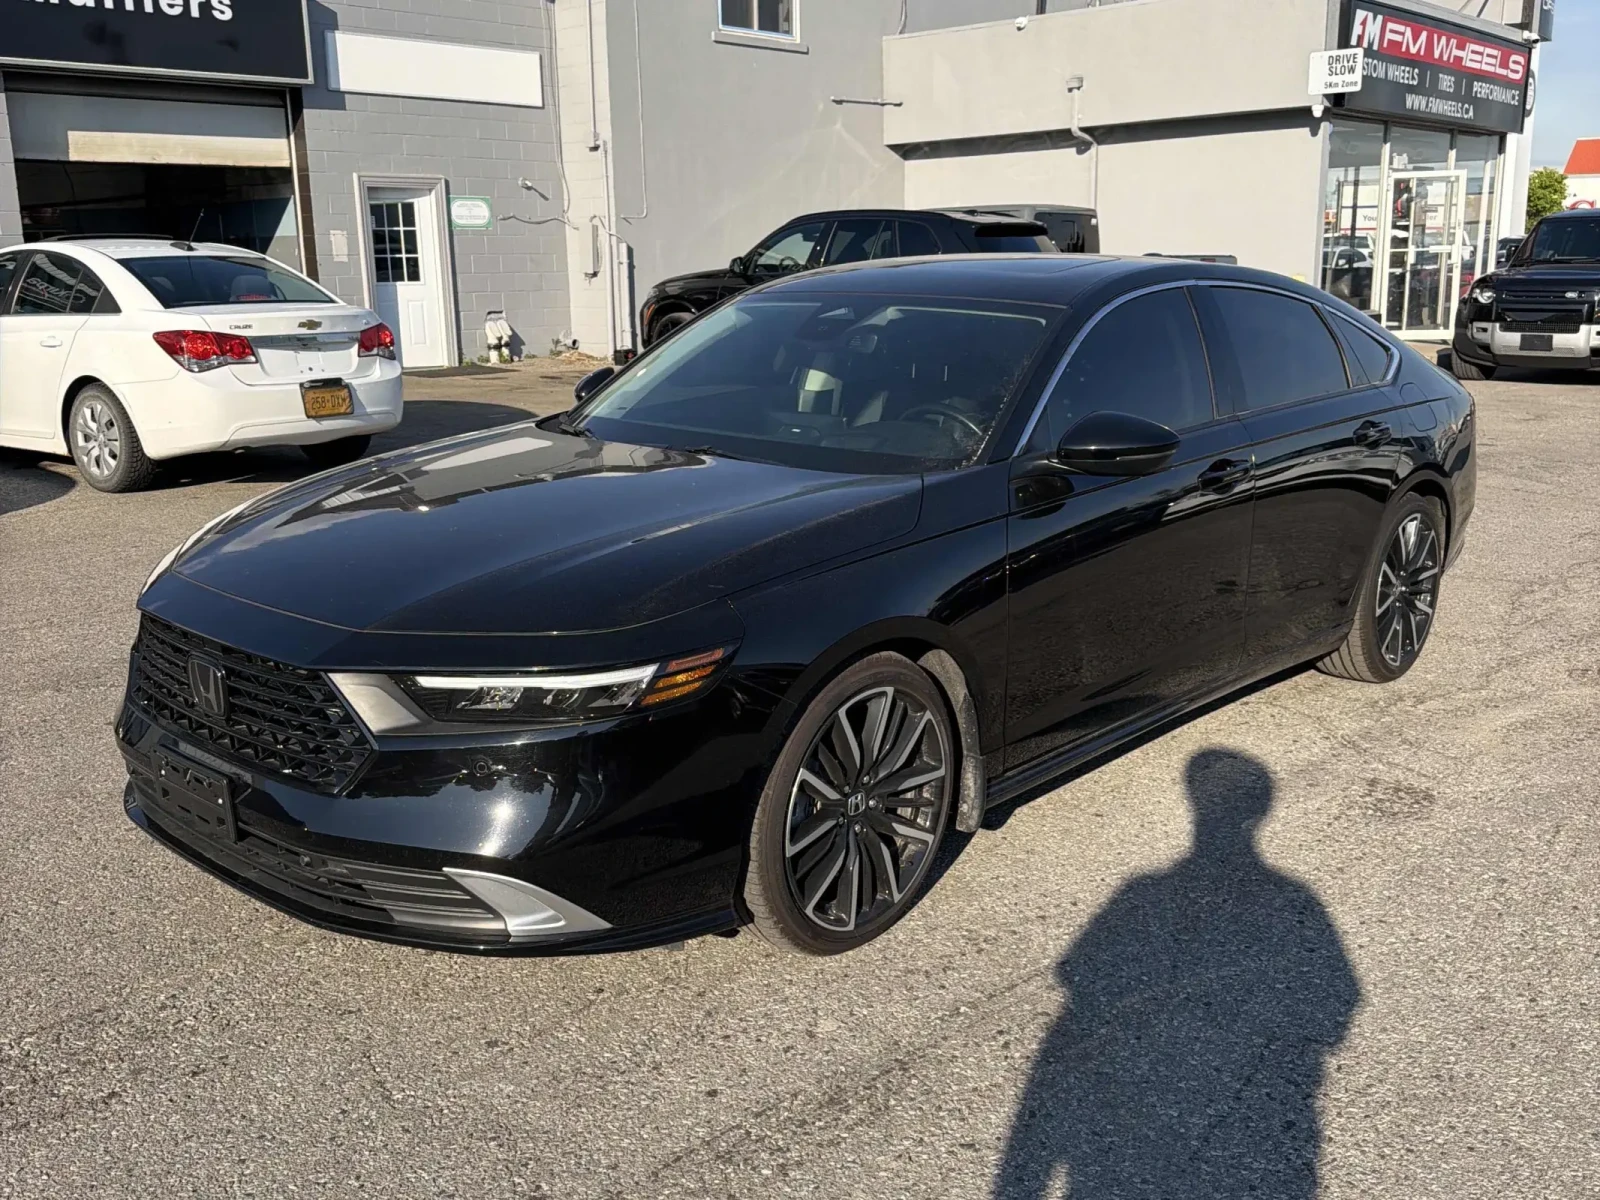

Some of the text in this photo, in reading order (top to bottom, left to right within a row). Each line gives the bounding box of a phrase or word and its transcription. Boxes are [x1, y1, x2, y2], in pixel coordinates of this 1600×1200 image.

[1327, 53, 1359, 66] DRIVE
[1383, 21, 1525, 80] FM WHEELS
[1327, 64, 1357, 77] SLOW
[1323, 80, 1358, 90] 5Km Zone
[1362, 57, 1386, 80] STOM
[1387, 62, 1419, 86] WHEELS
[1438, 73, 1455, 93] TIRES
[1472, 80, 1520, 106] PERFORMANCE
[1405, 92, 1474, 120] WWW.FMWHEELS.CA
